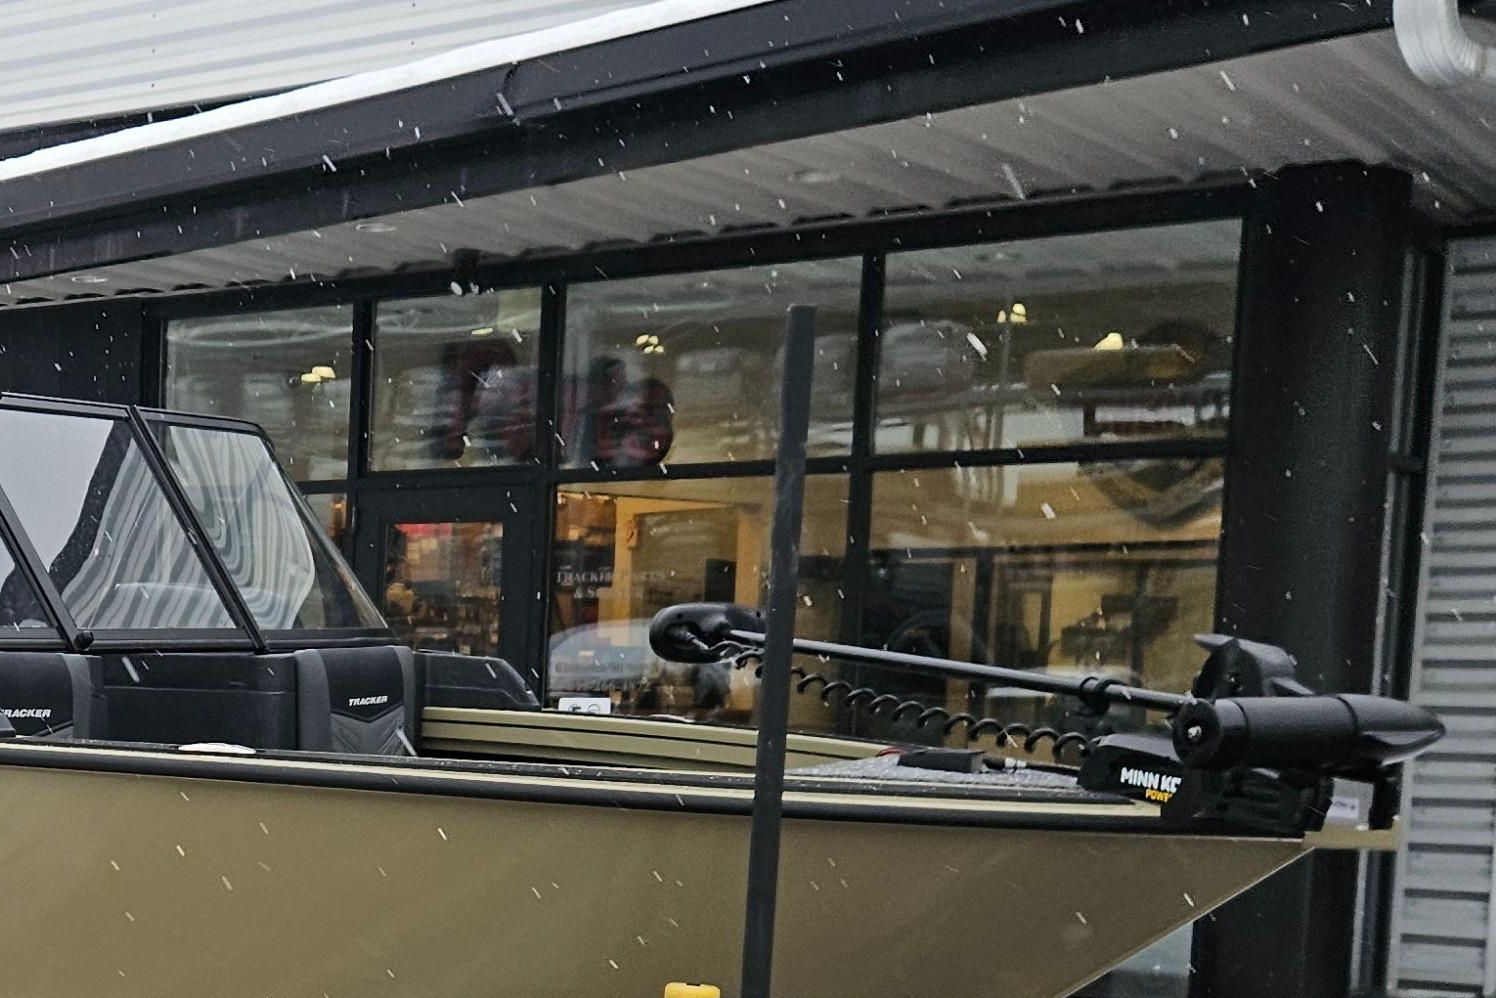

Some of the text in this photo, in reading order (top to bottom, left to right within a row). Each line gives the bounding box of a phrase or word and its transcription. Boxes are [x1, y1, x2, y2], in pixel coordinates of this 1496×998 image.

[348, 695, 388, 706] TRACKER
[2, 708, 52, 718] RACKER
[1120, 766, 1160, 790] MINN
